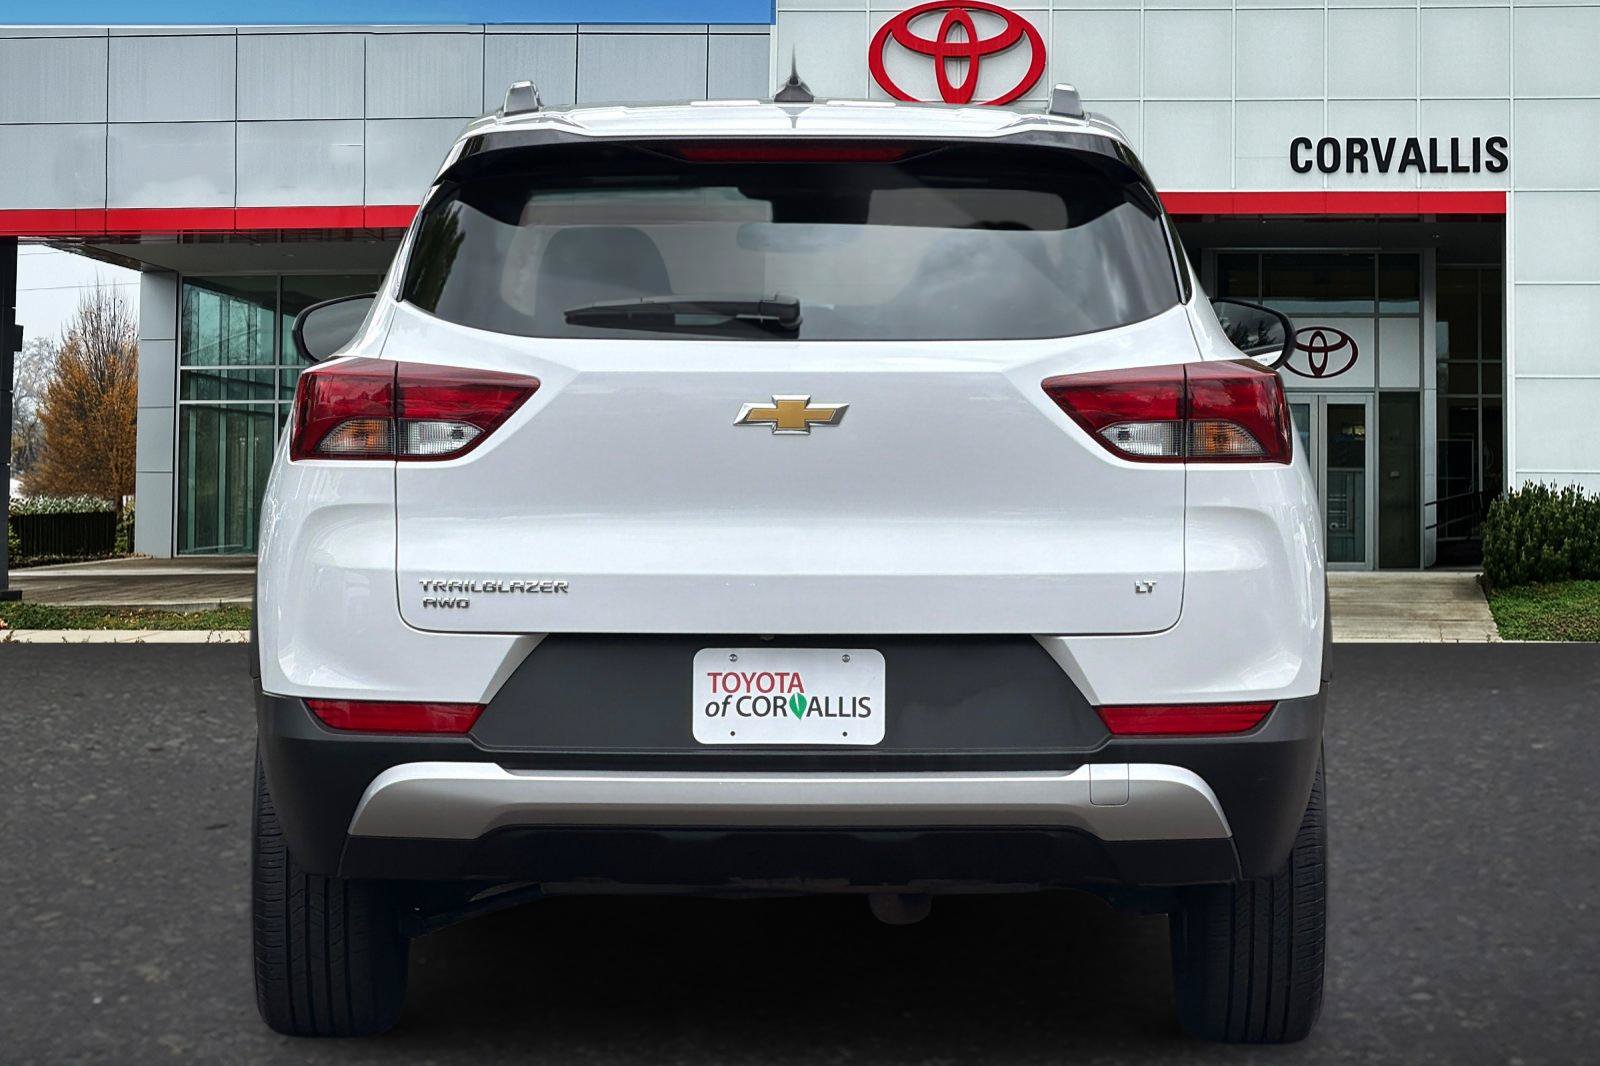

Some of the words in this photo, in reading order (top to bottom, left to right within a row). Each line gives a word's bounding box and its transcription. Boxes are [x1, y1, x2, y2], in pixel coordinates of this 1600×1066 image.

[1289, 136, 1509, 174] CORVALLIS
[419, 578, 569, 594] TRAILBLAZER
[1135, 579, 1157, 593] LT
[422, 596, 471, 609] AWD
[707, 671, 805, 694] TOYOTA
[705, 694, 733, 717] of
